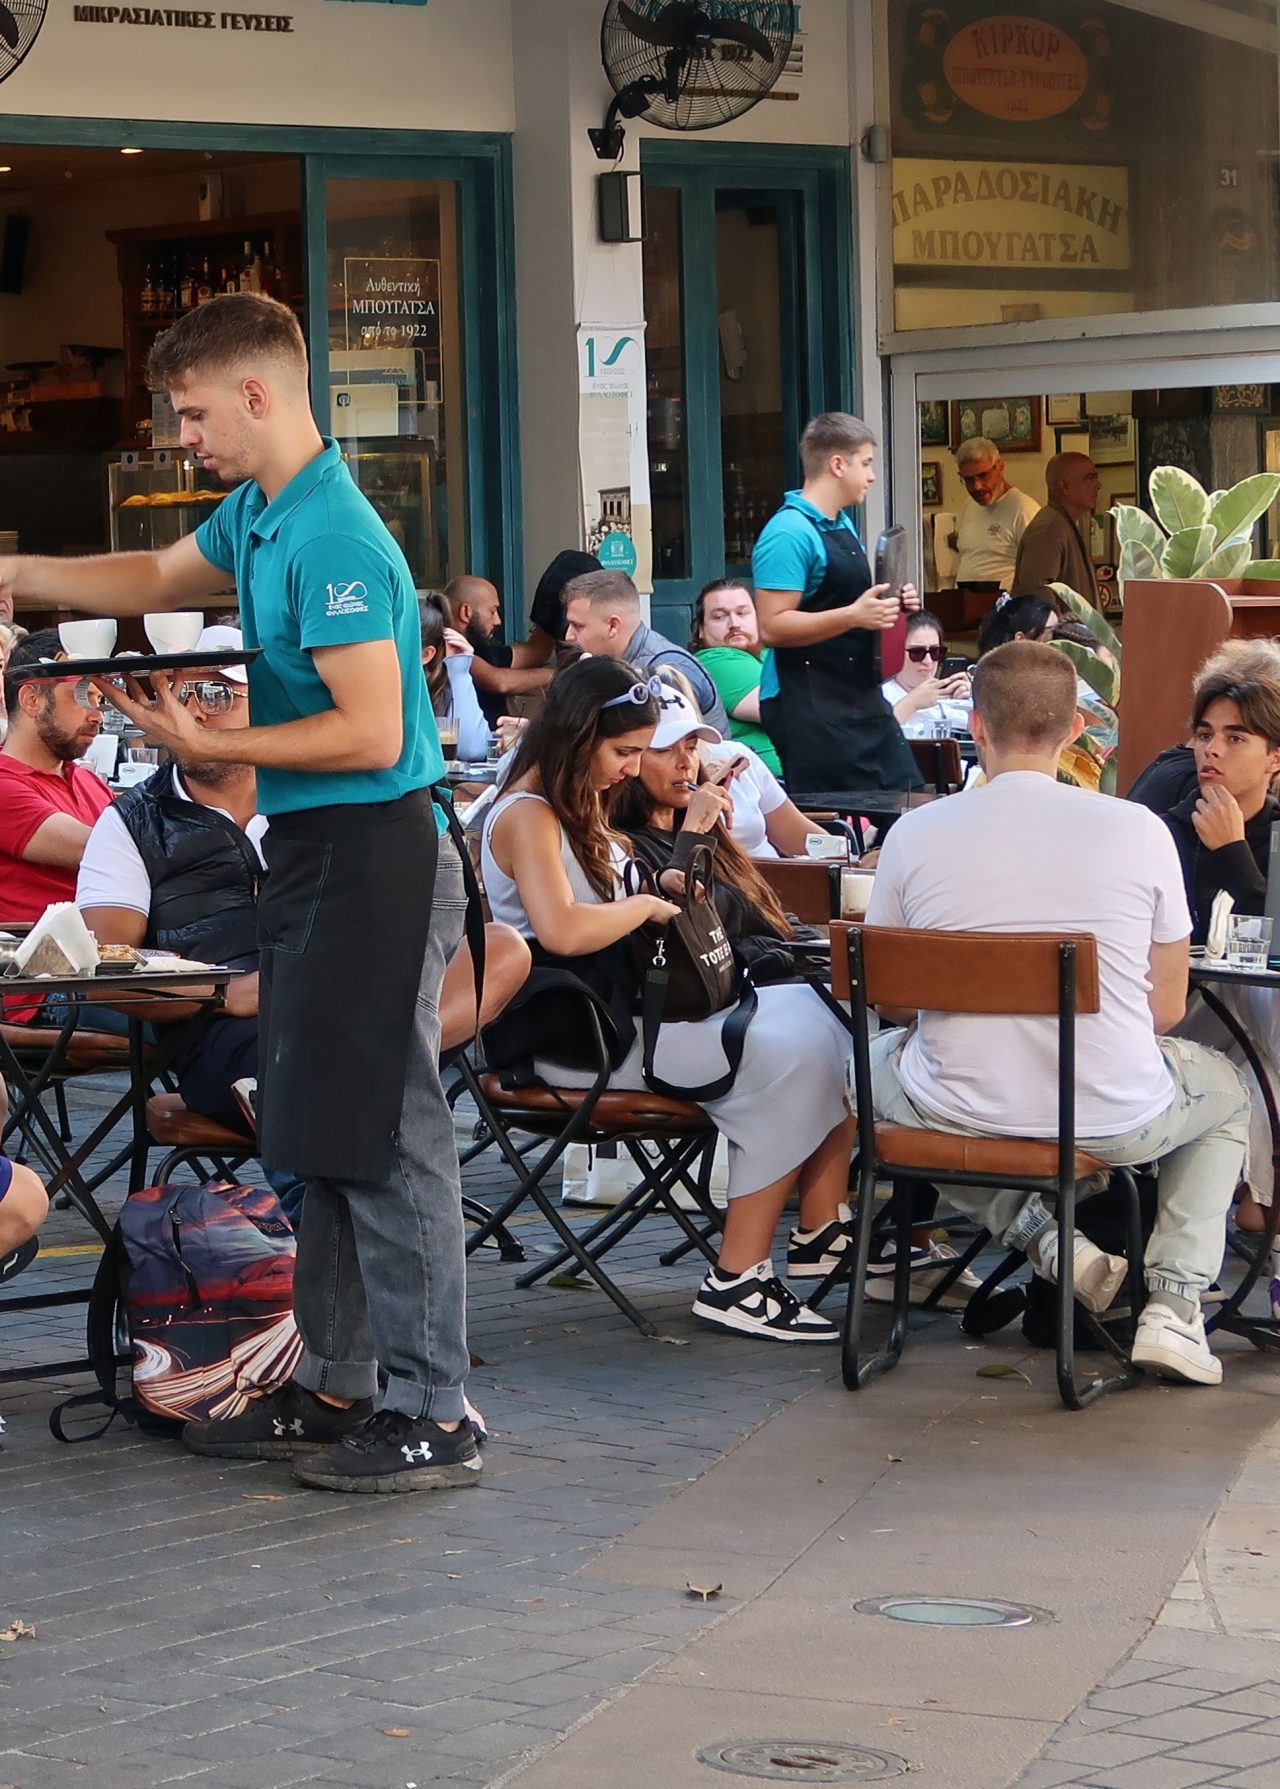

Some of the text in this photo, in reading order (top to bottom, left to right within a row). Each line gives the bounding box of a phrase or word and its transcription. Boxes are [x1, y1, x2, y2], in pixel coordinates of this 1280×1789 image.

[73, 5, 295, 33] ΜΙΚΡΑΣΙΑΤΙΚΕΣ ΓΕΥΣΕΙΣ
[1220, 168, 1238, 187] 31
[892, 168, 1124, 236] ΠΑΡΑΔΟΣΙΑΚΗ
[911, 230, 1100, 264] ΜΠΟΥΓΑΤΣΑ
[365, 277, 421, 296] Αυθεντική
[352, 299, 435, 316] ΜΠΟΥΓΑΤΣΑ
[401, 324, 428, 337] 1922
